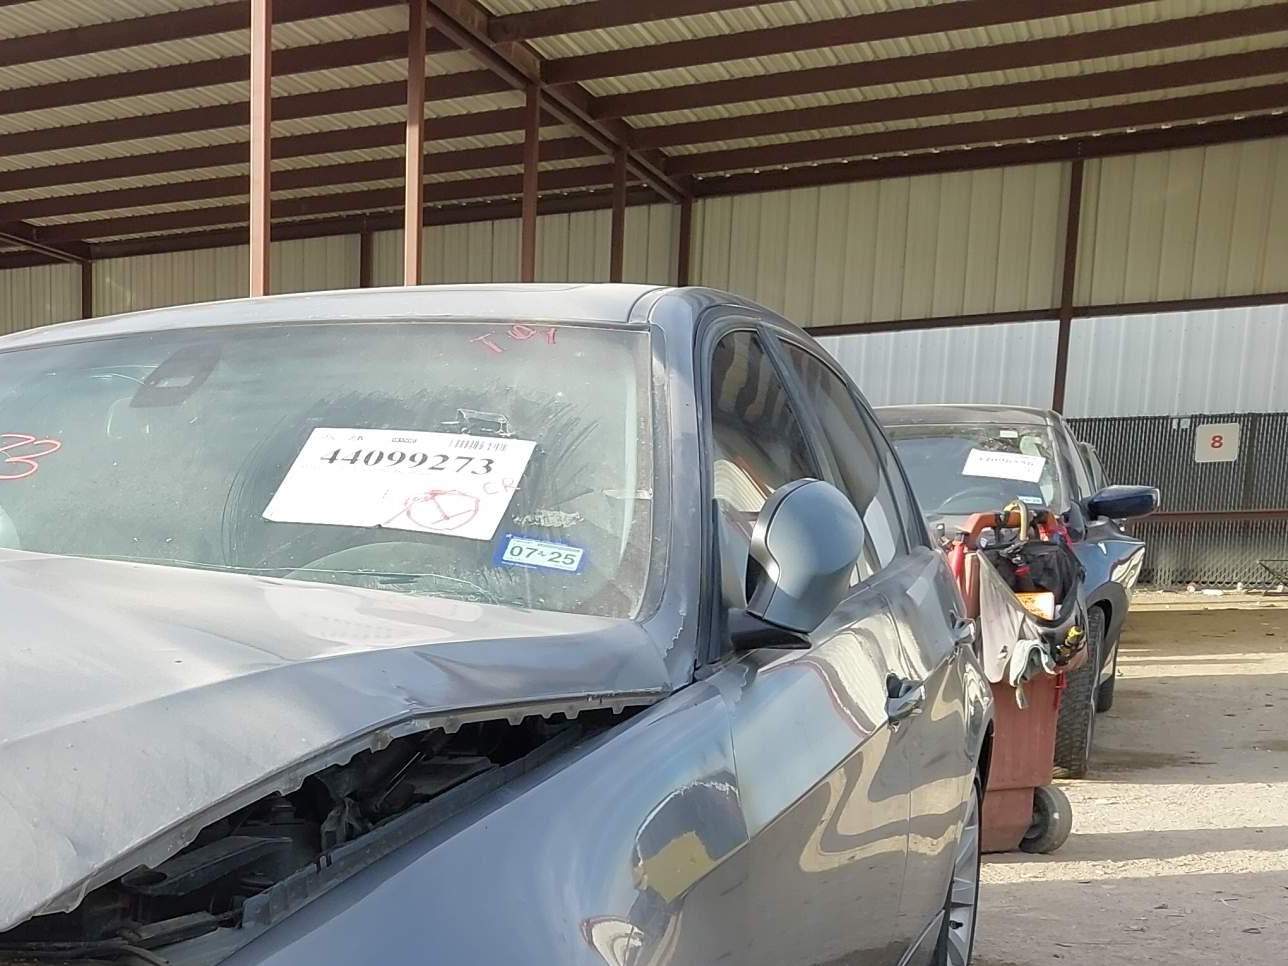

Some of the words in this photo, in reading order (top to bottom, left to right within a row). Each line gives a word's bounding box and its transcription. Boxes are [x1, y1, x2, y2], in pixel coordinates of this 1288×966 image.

[1210, 434, 1224, 449] 8
[319, 447, 495, 476] 44099273
[509, 545, 538, 559] 07
[546, 551, 577, 566] 25
